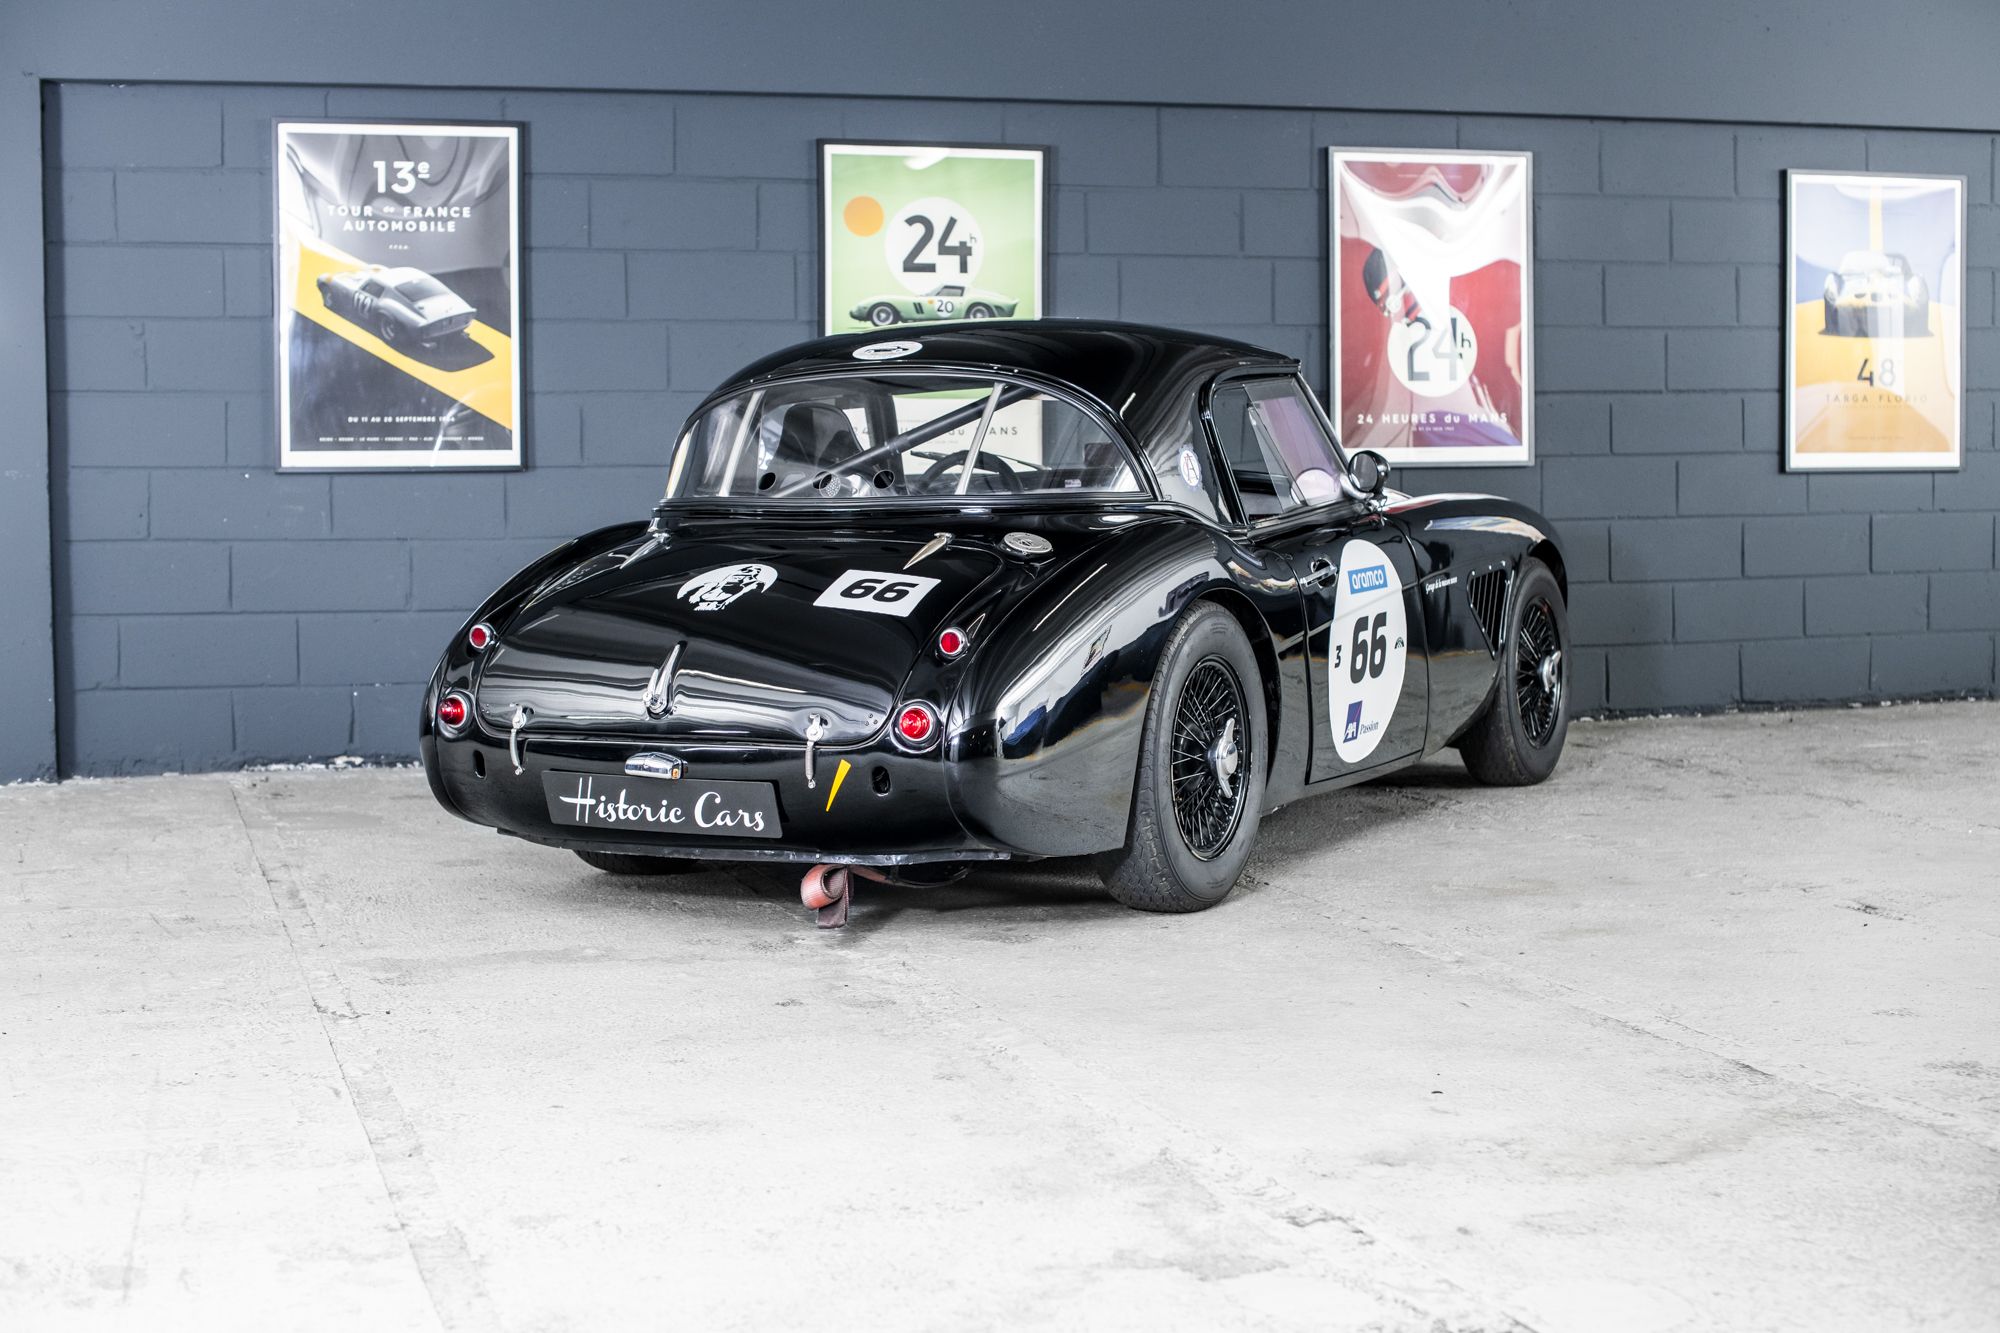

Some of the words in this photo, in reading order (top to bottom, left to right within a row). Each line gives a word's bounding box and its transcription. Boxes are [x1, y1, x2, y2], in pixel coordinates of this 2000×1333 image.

[327, 205, 373, 217] TOUR
[383, 205, 396, 213] de
[403, 206, 472, 218] FRANCE
[343, 220, 456, 233] AUTOMOBILE
[936, 299, 954, 314] 20
[1857, 358, 1896, 388] 48
[1826, 394, 1869, 403] TARGA
[1357, 414, 1374, 424] 24
[1382, 413, 1436, 424] HEURES
[1444, 413, 1461, 424] du
[1468, 412, 1508, 424] MANS
[988, 426, 1018, 436] ANS
[1351, 569, 1385, 590] aramco
[840, 578, 919, 602] 66
[1350, 611, 1387, 684] 66
[1334, 644, 1342, 669] 3
[1359, 720, 1379, 735] Passion
[559, 776, 685, 824] Historic
[694, 791, 765, 832] Cars
